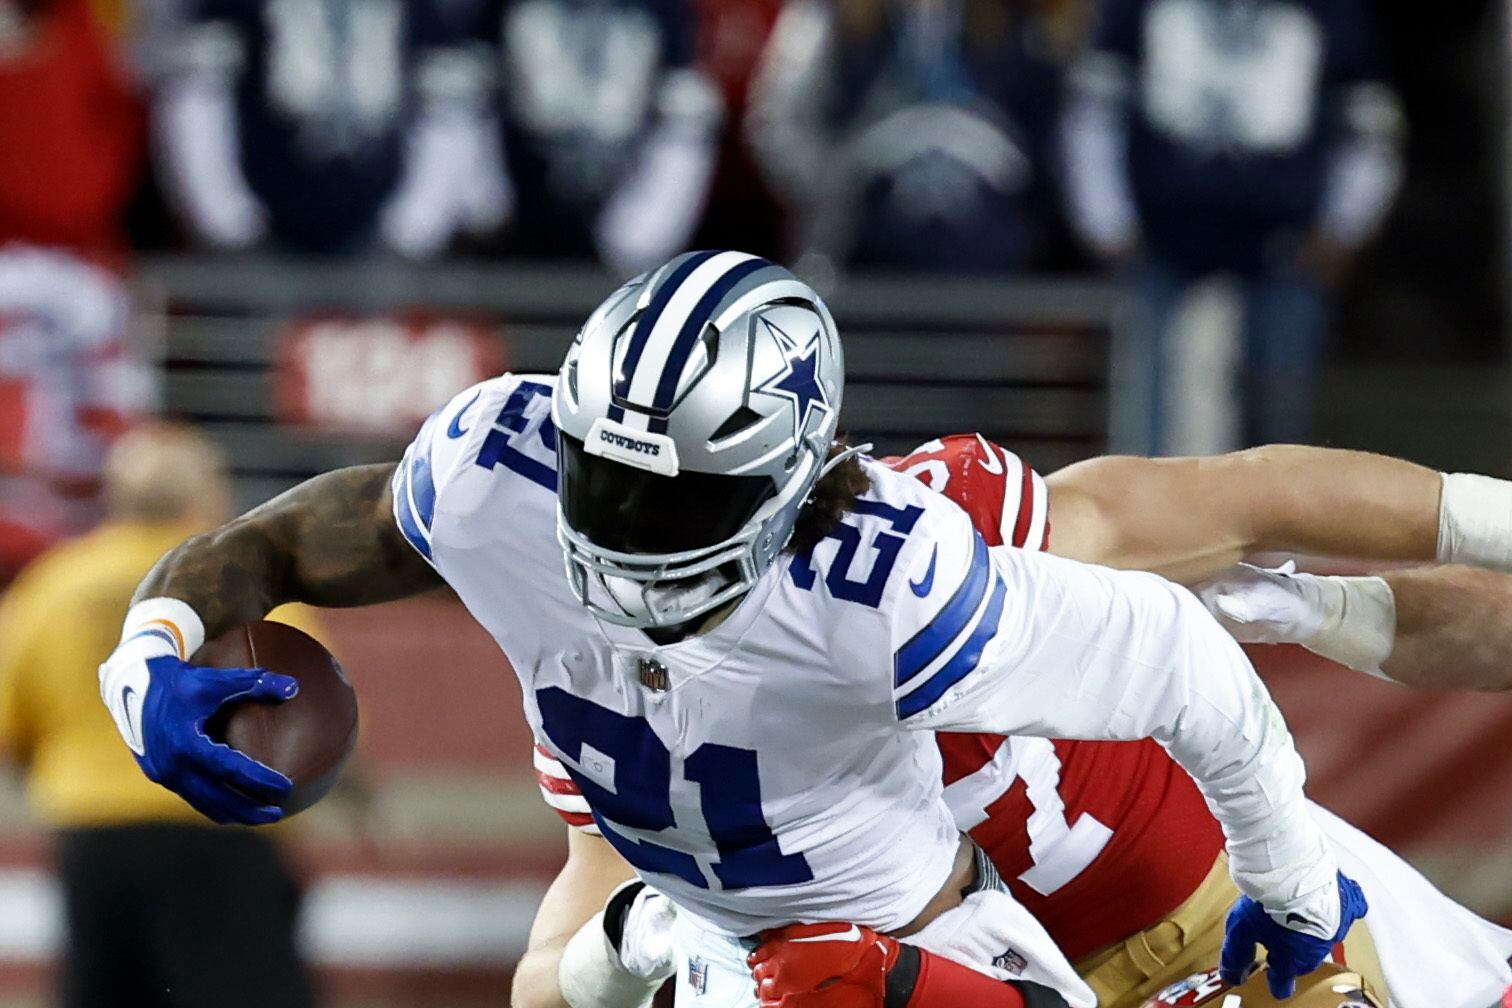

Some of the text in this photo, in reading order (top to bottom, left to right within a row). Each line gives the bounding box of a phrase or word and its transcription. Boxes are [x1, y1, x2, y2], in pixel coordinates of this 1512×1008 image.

[600, 430, 661, 457] COWBOYS
[788, 499, 927, 610] 21
[535, 684, 815, 891] 21
